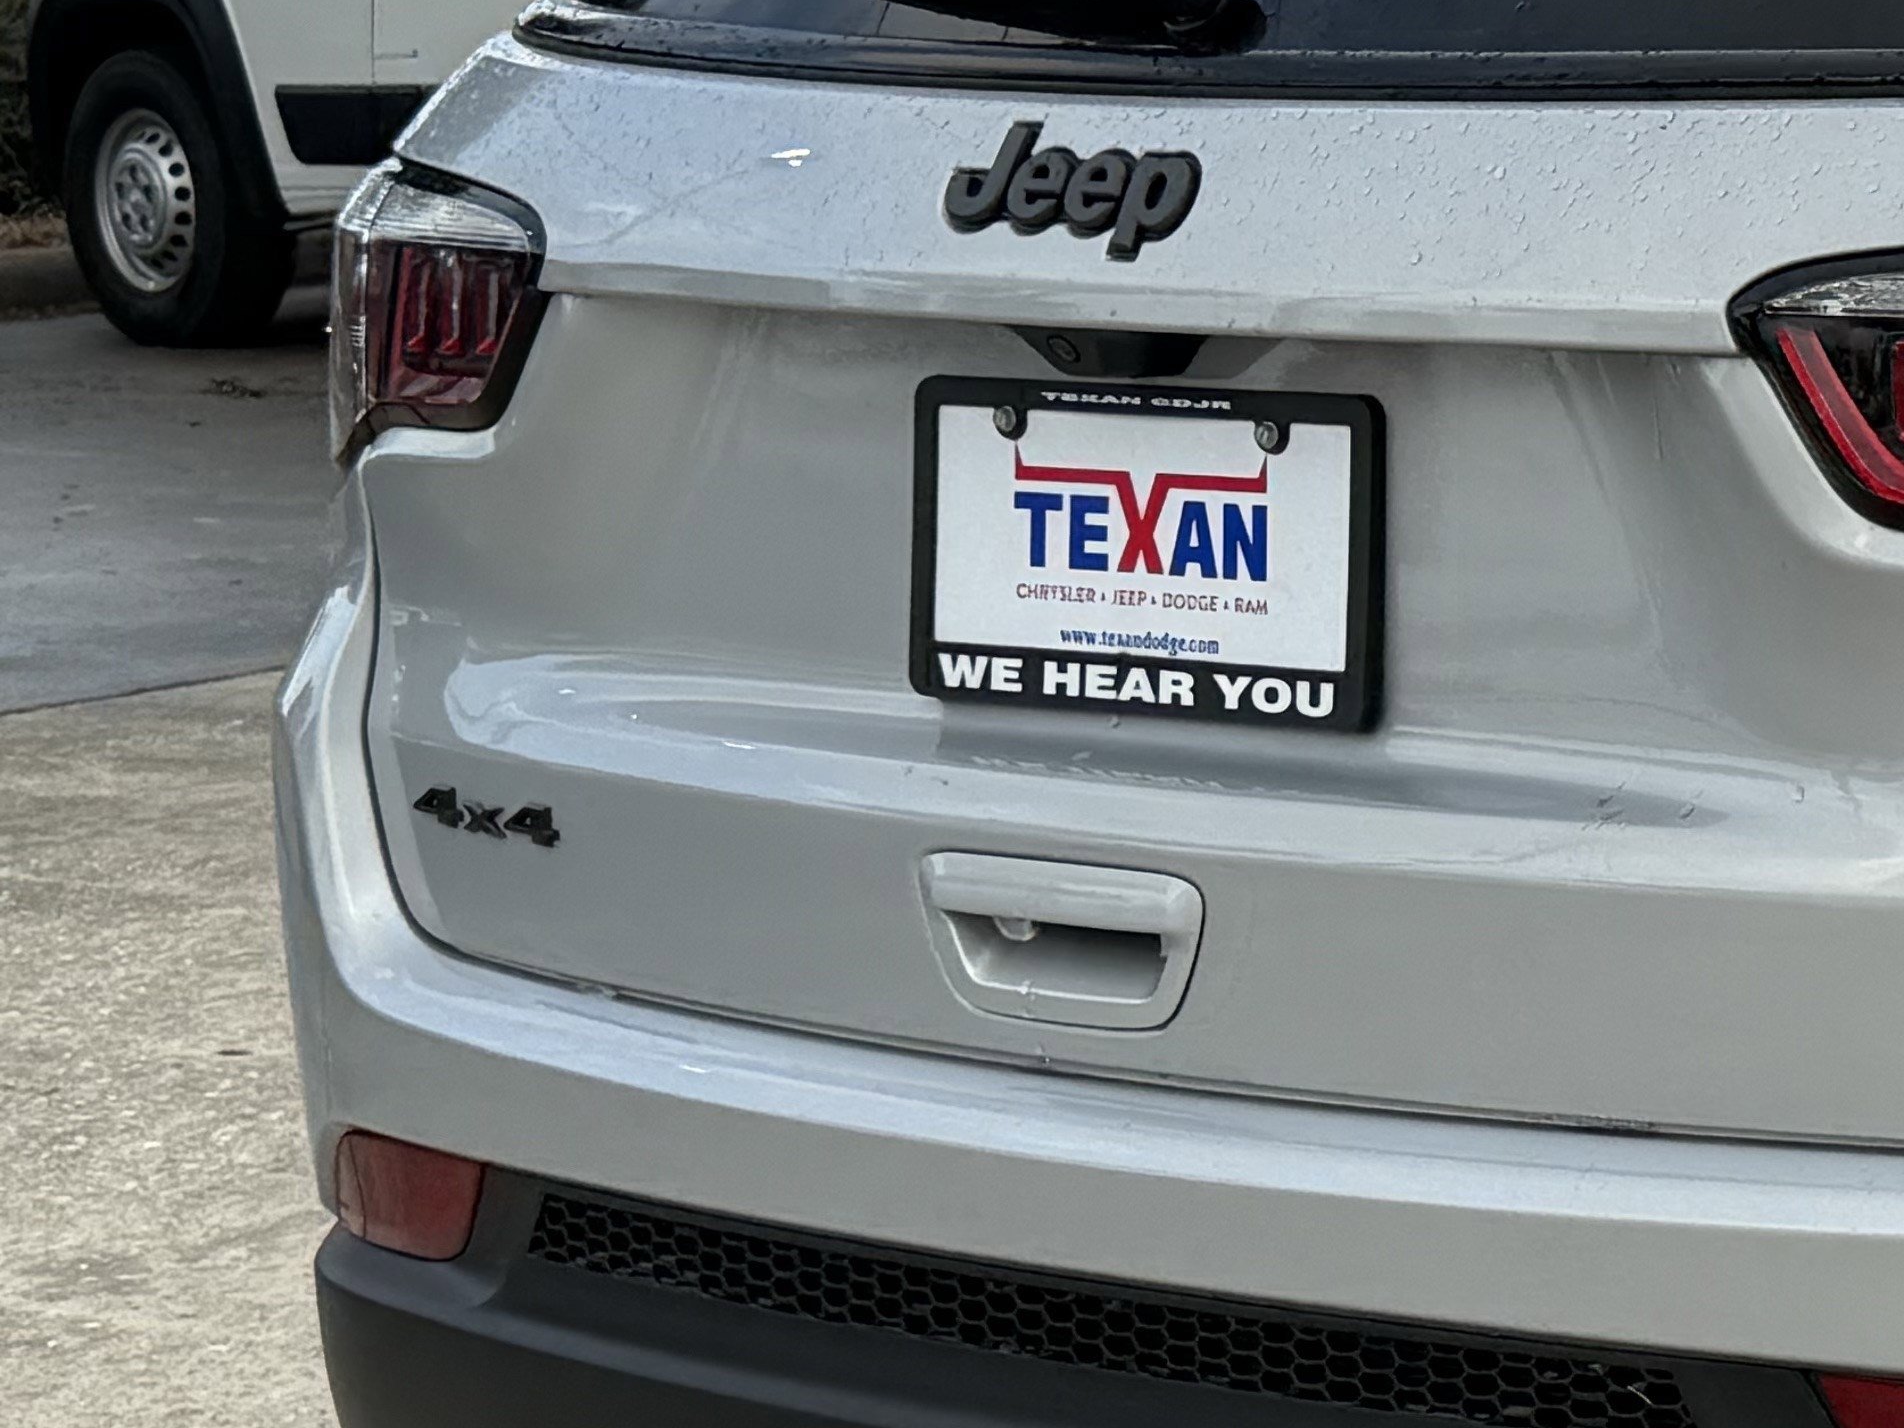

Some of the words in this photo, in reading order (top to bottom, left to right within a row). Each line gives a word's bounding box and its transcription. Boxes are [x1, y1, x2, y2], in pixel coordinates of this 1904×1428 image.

[944, 120, 1203, 263] Jeep
[1039, 390, 1142, 406] TEXAN
[1014, 466, 1268, 582] TEXAN
[1015, 582, 1096, 604] CHRYSLER
[1109, 589, 1147, 607] JEEP
[1161, 592, 1219, 613] DODGE
[1233, 596, 1270, 616] RAM
[1059, 628, 1221, 656] www.texandodge.com
[937, 652, 1023, 693] WE
[1042, 661, 1196, 708] HEAR
[1213, 673, 1337, 718] YOU
[412, 784, 562, 849] 4x4
